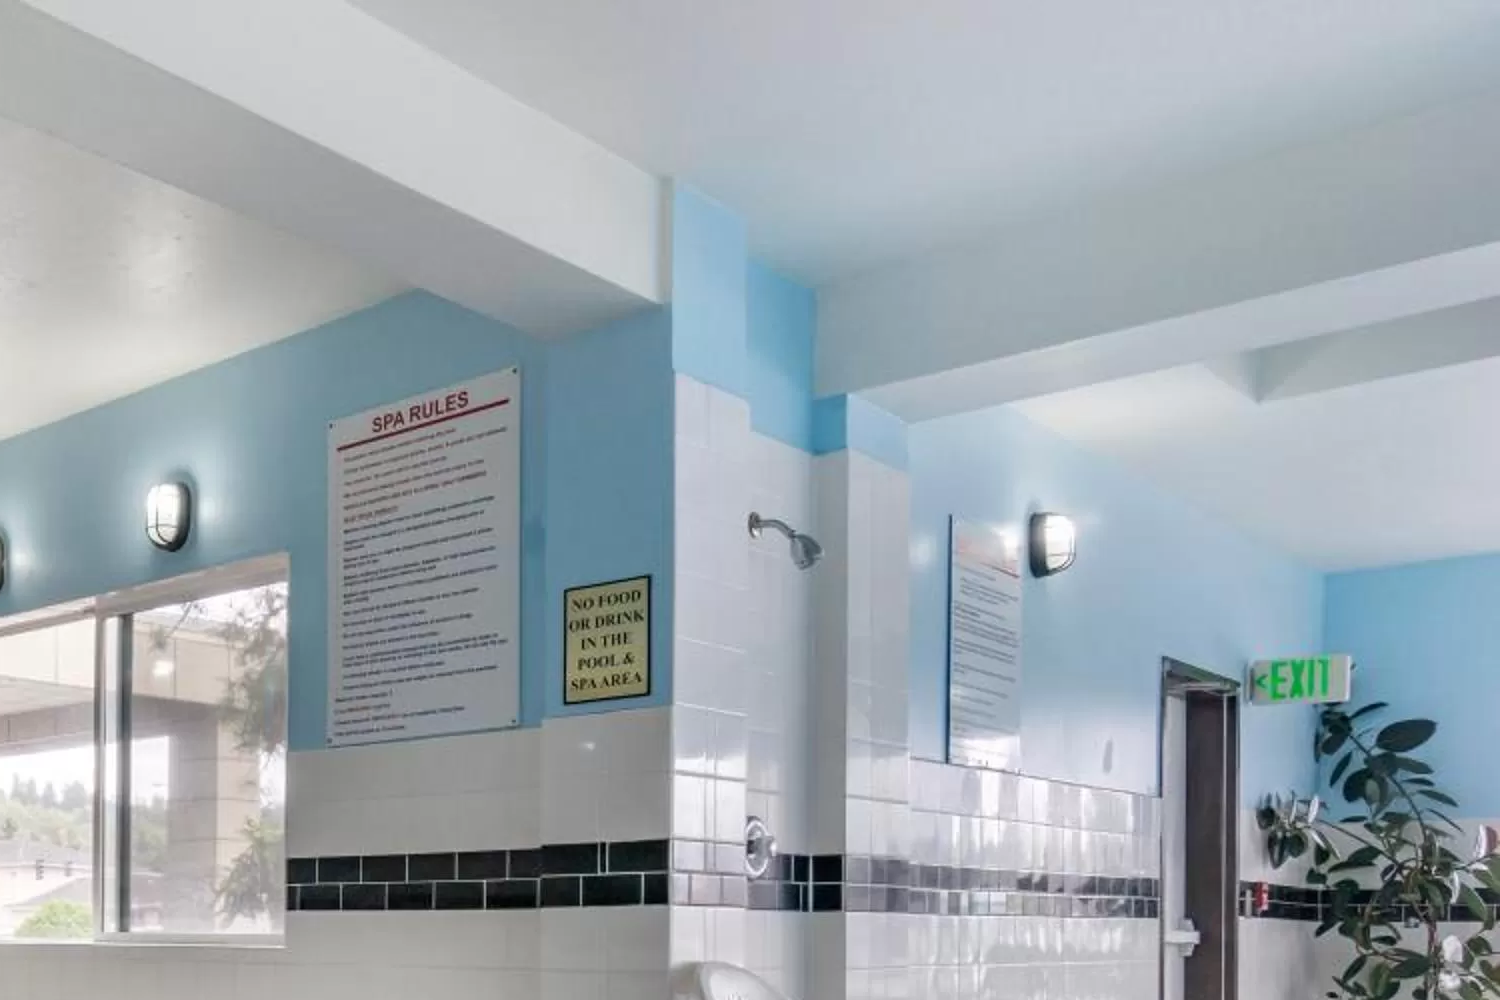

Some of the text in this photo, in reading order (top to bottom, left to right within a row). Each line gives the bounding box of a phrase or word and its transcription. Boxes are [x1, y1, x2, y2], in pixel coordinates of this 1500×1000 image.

[371, 391, 469, 433] SPA RULES
[572, 590, 641, 613] NO FOOD
[569, 609, 644, 633] OR DRINK
[581, 631, 632, 650] IN THE
[577, 652, 635, 671] POOL &
[570, 671, 643, 691] SPA AREA
[1270, 658, 1329, 700] EXIT
